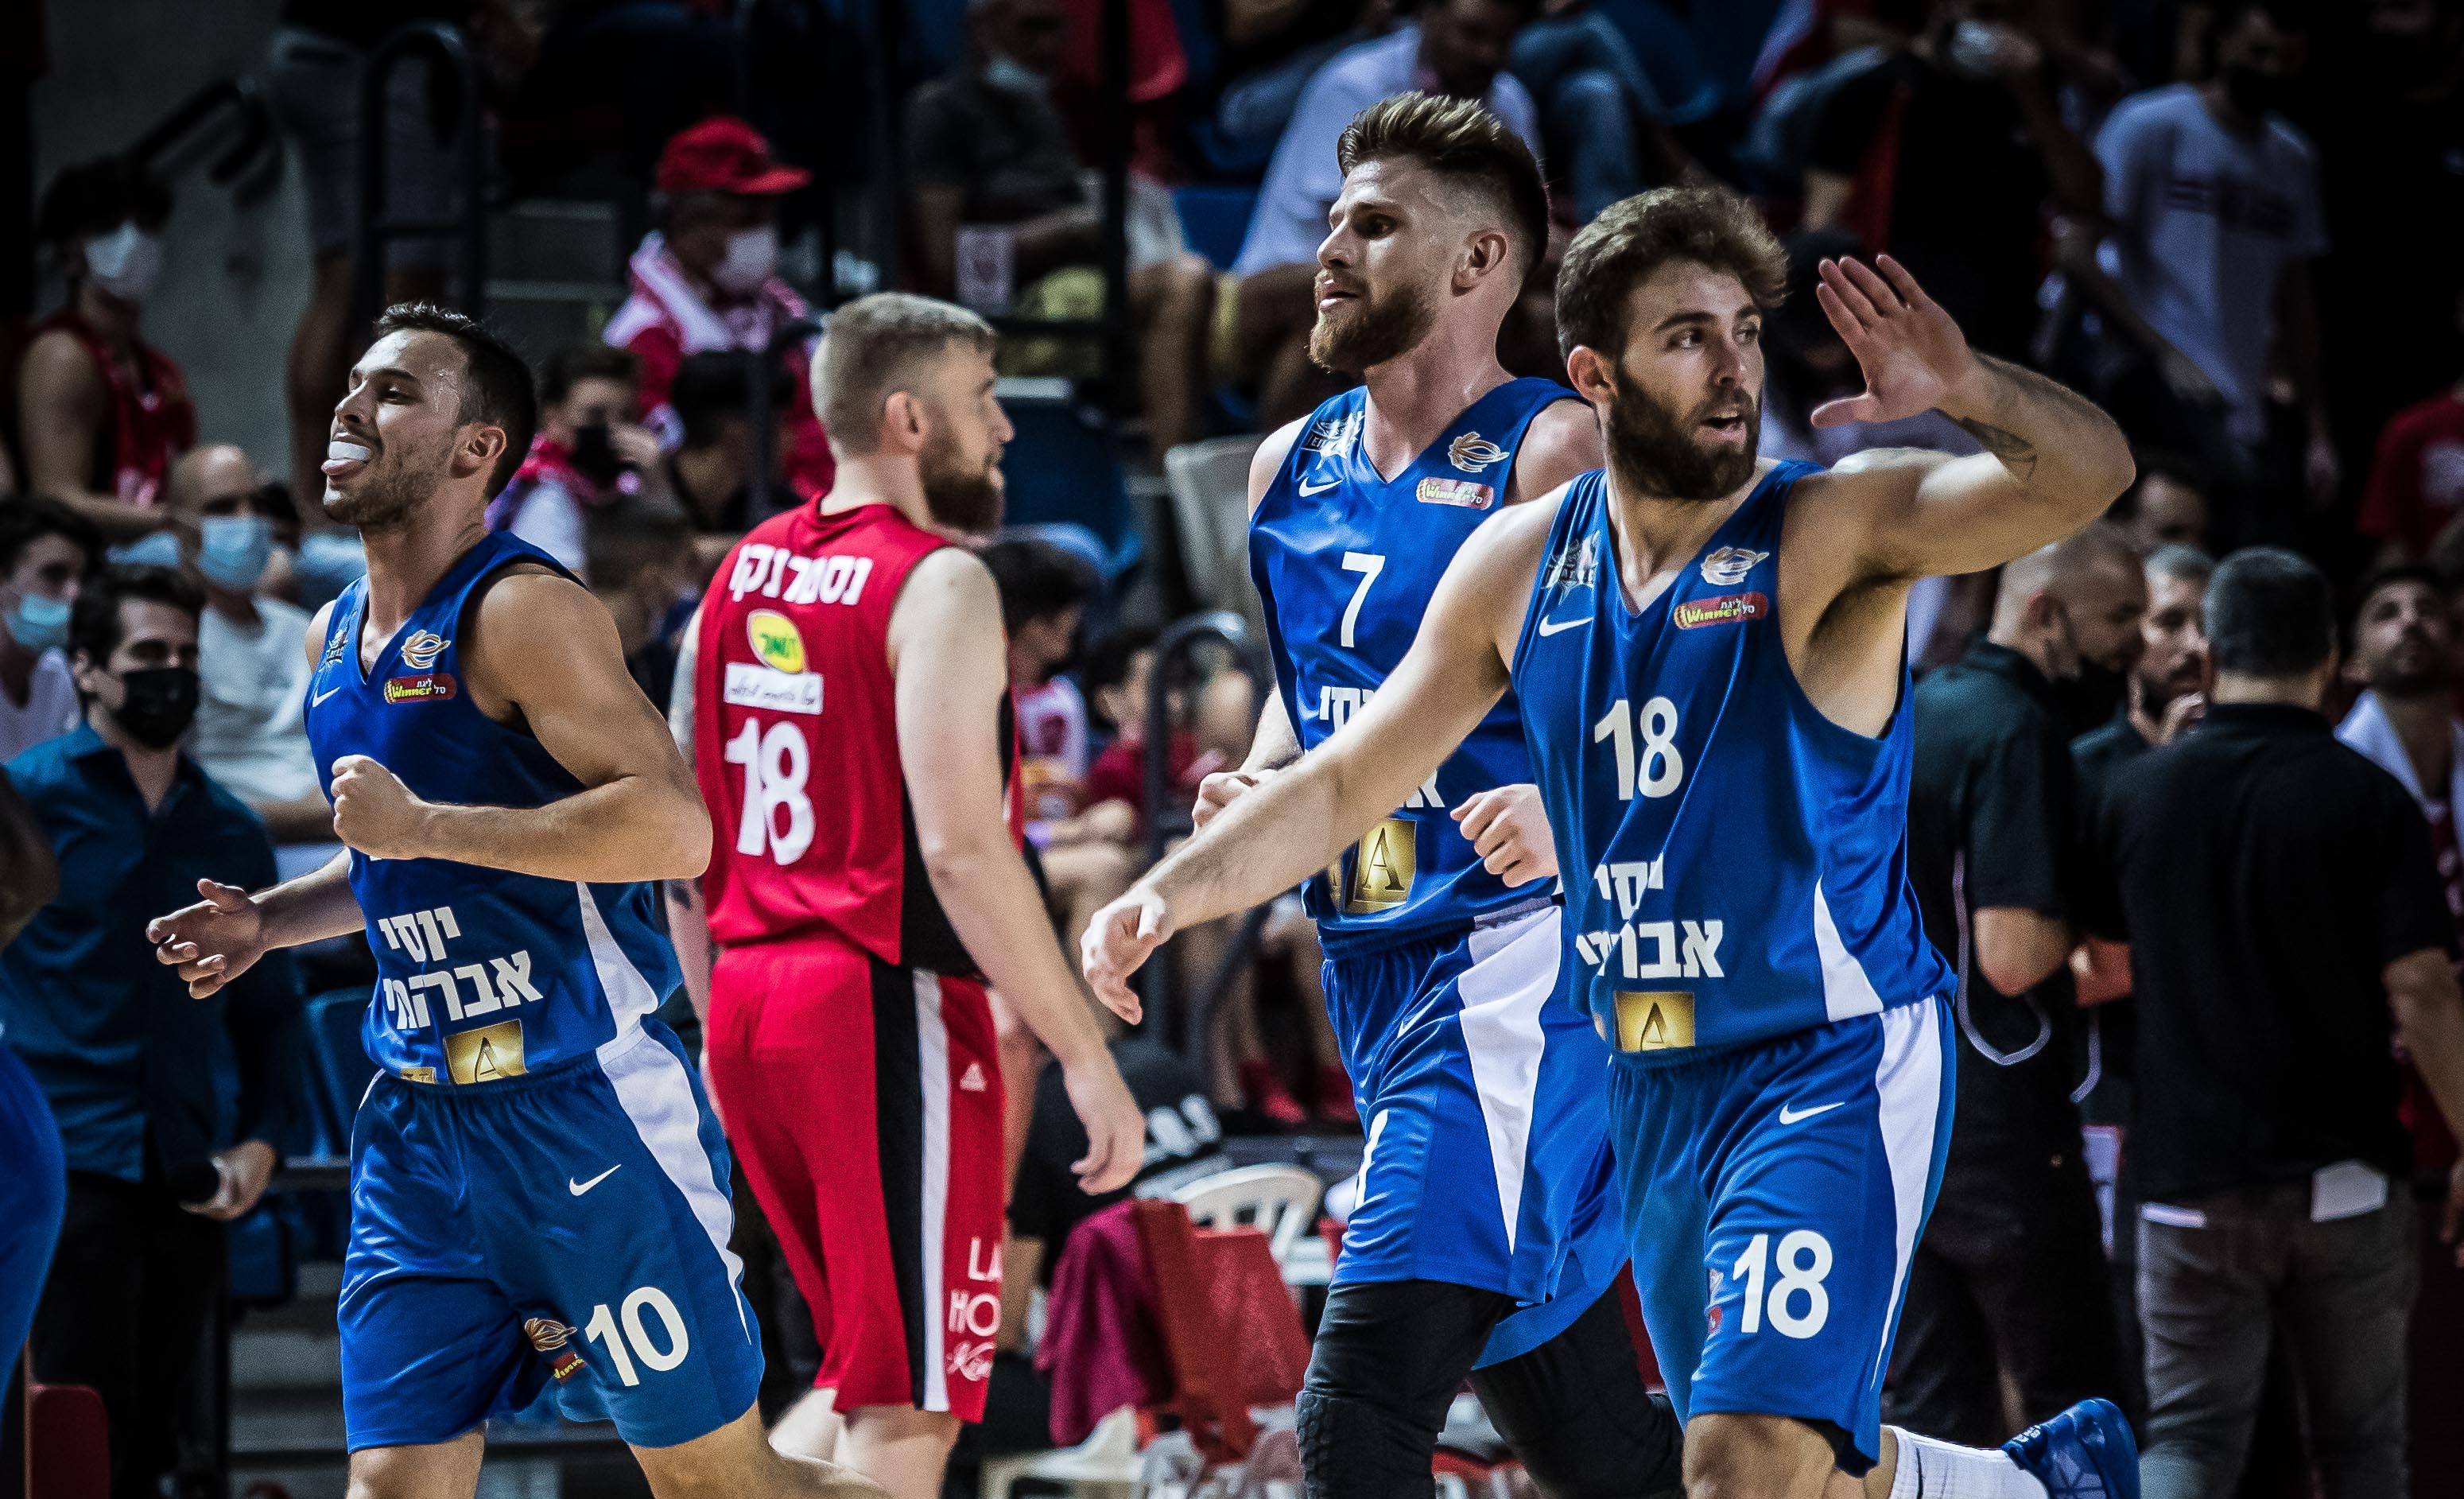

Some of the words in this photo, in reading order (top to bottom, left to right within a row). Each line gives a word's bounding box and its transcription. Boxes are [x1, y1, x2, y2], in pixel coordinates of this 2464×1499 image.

[1341, 551, 1386, 648] 7
[1686, 608, 1739, 623] Winner
[391, 685, 432, 698] Winner
[724, 716, 817, 866] 18
[1594, 697, 1683, 801] 18
[1363, 827, 1406, 891] A
[378, 906, 461, 962] יוסי
[1733, 1229, 1833, 1339] 18
[584, 1286, 689, 1387] 10
